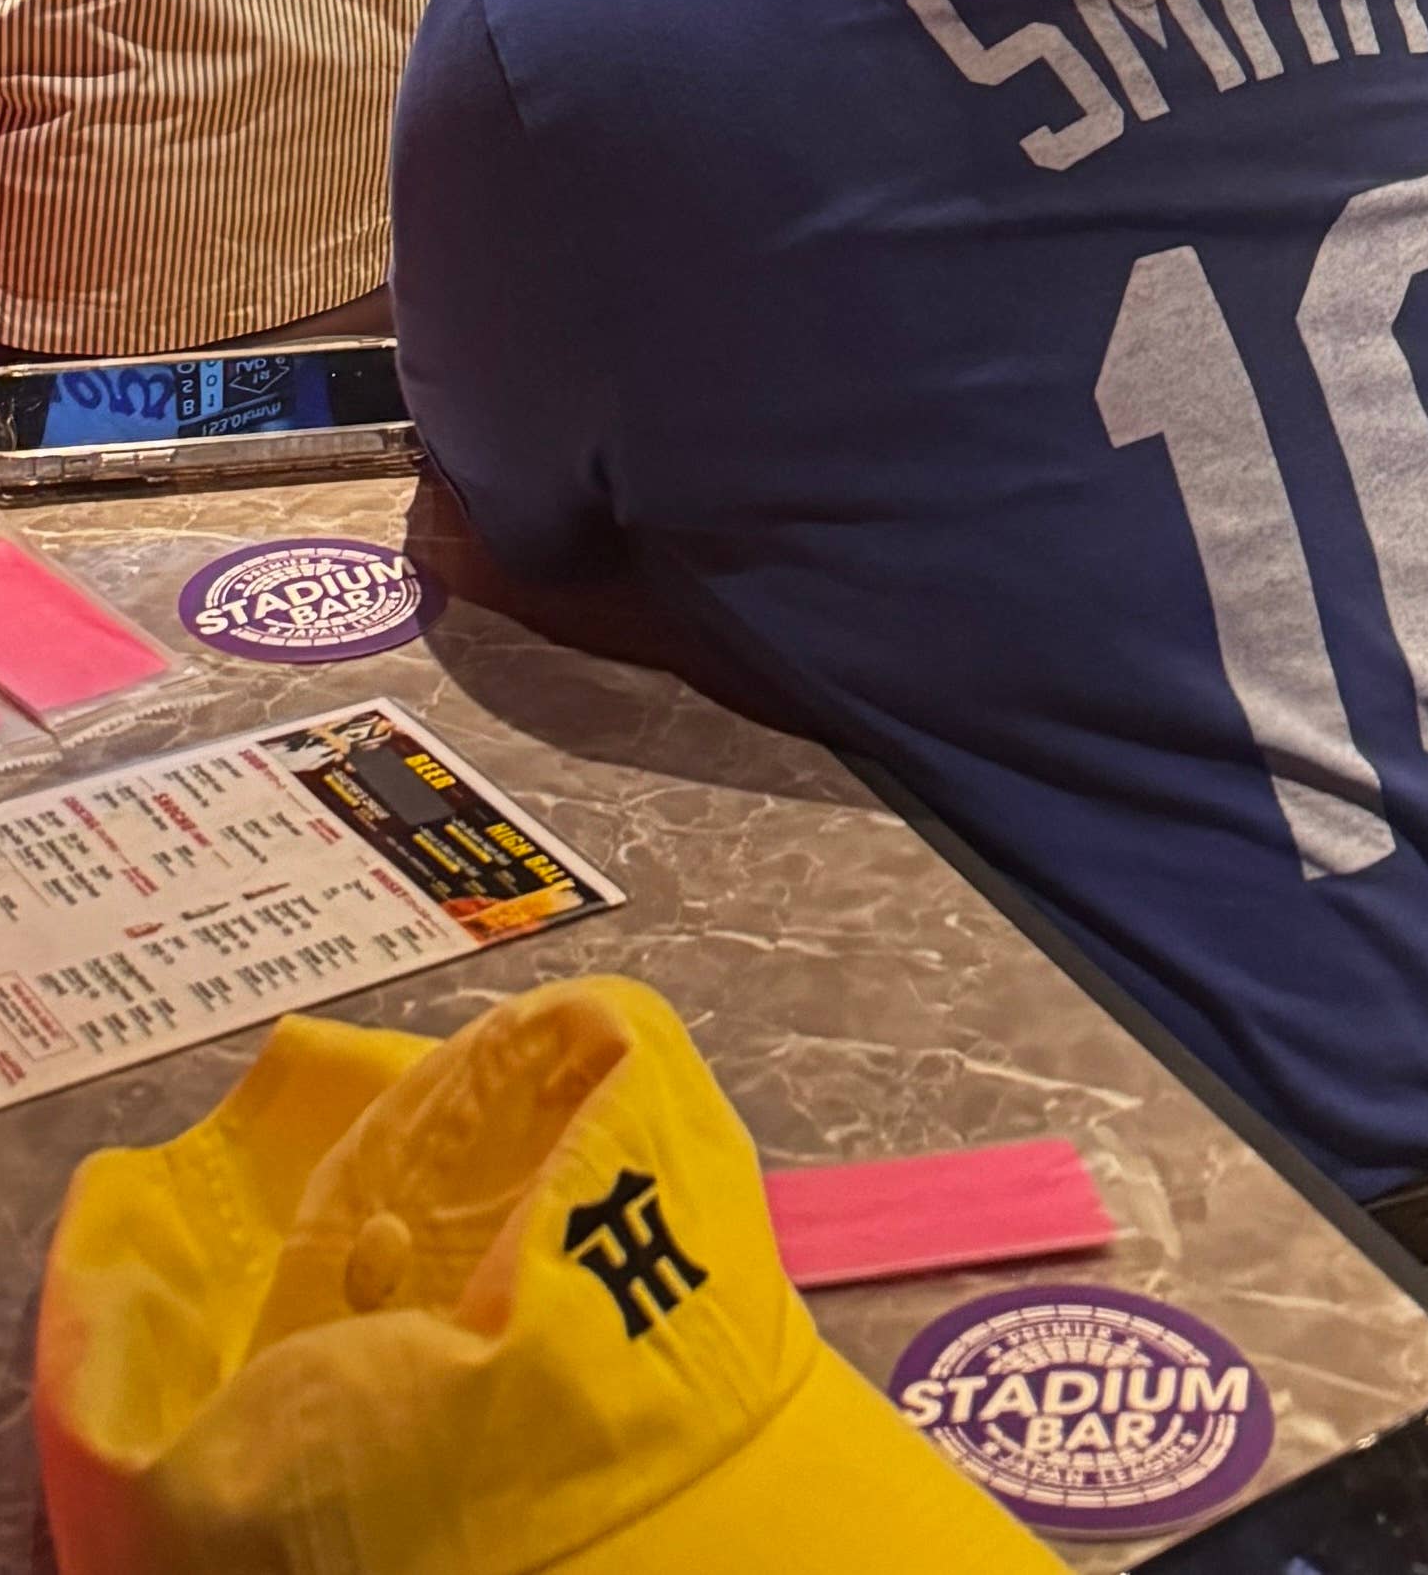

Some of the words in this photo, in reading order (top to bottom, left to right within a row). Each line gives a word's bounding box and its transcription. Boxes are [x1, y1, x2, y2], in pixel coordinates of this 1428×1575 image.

[195, 555, 417, 635] STADIUM
[290, 589, 374, 628] BAR
[404, 752, 457, 790] BEER
[483, 820, 537, 863] HIGH
[1006, 1320, 1114, 1346] PREMIER
[900, 1367, 1250, 1428] STADIUM
[1025, 1411, 1156, 1452] BAR
[1000, 1450, 1084, 1485] JAPAN
